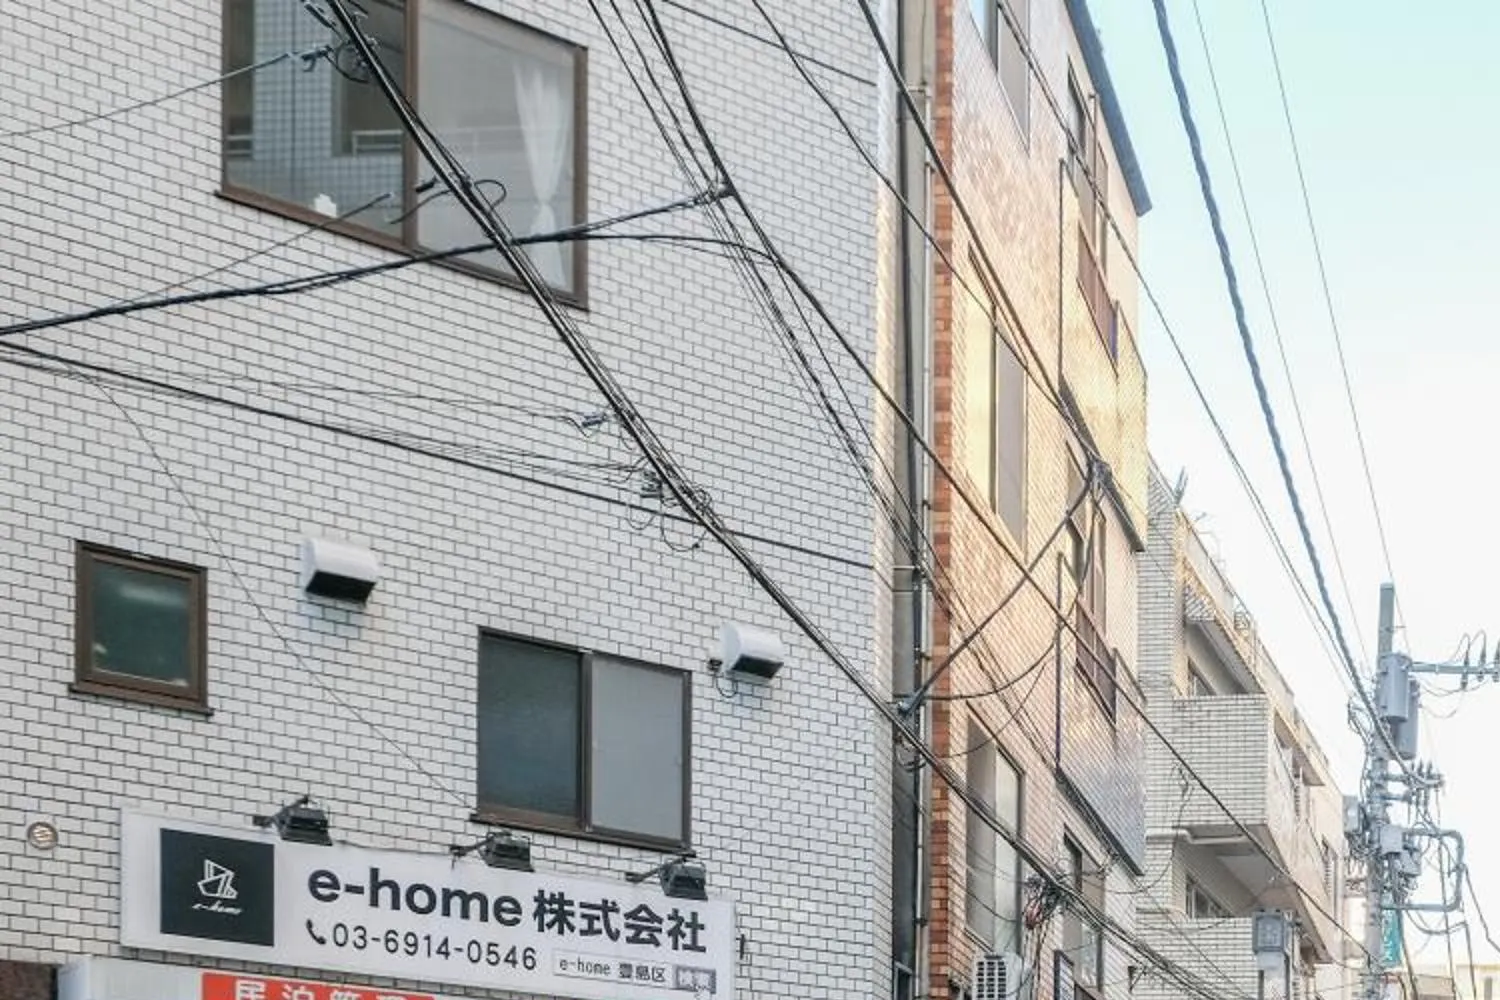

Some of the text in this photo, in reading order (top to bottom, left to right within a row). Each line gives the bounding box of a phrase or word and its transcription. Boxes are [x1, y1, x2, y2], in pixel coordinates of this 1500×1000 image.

[308, 867, 707, 953] e-home 株式会社
[333, 923, 537, 970] 03-6914-0546
[559, 957, 665, 982] e-home 豊島区
